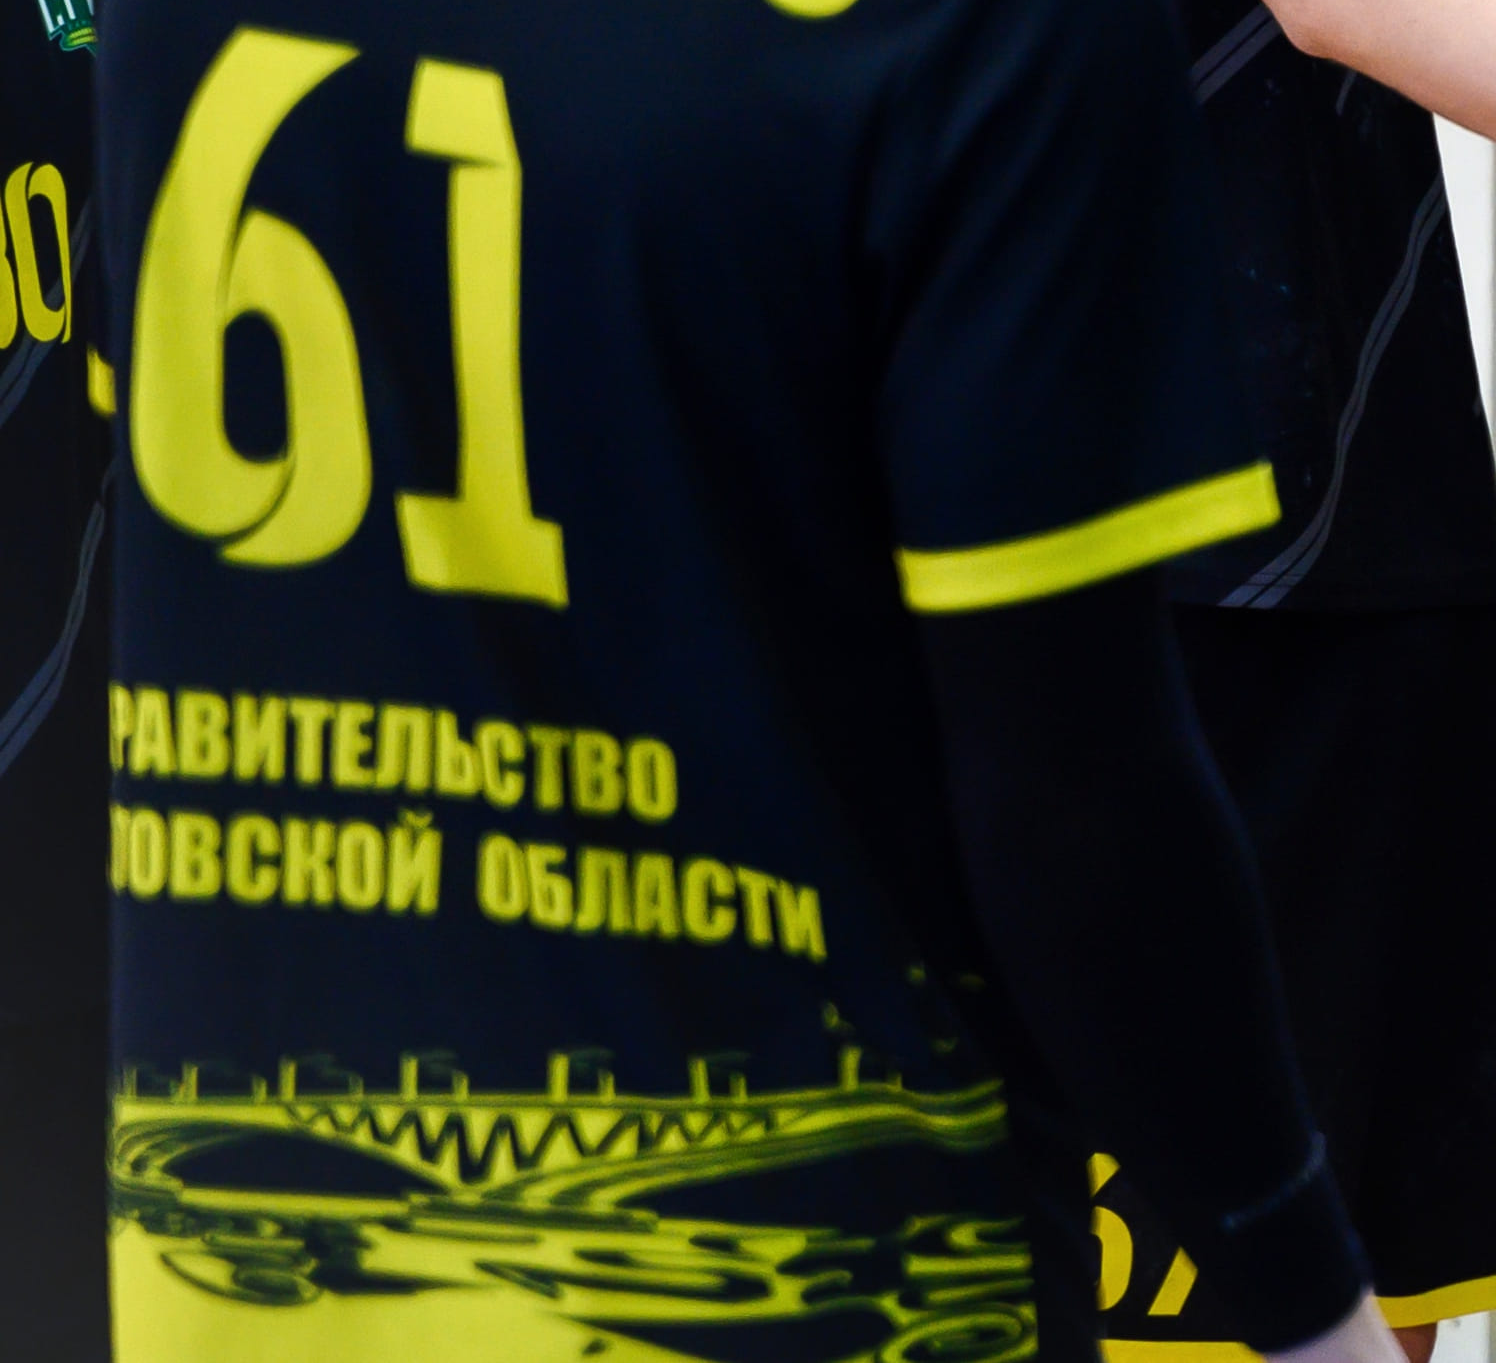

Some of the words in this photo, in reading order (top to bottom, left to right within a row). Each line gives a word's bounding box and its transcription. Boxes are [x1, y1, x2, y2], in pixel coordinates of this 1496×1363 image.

[0, 161, 72, 350] 0
[130, 27, 569, 607] 61
[476, 833, 829, 963] ОБЛАСТИ
